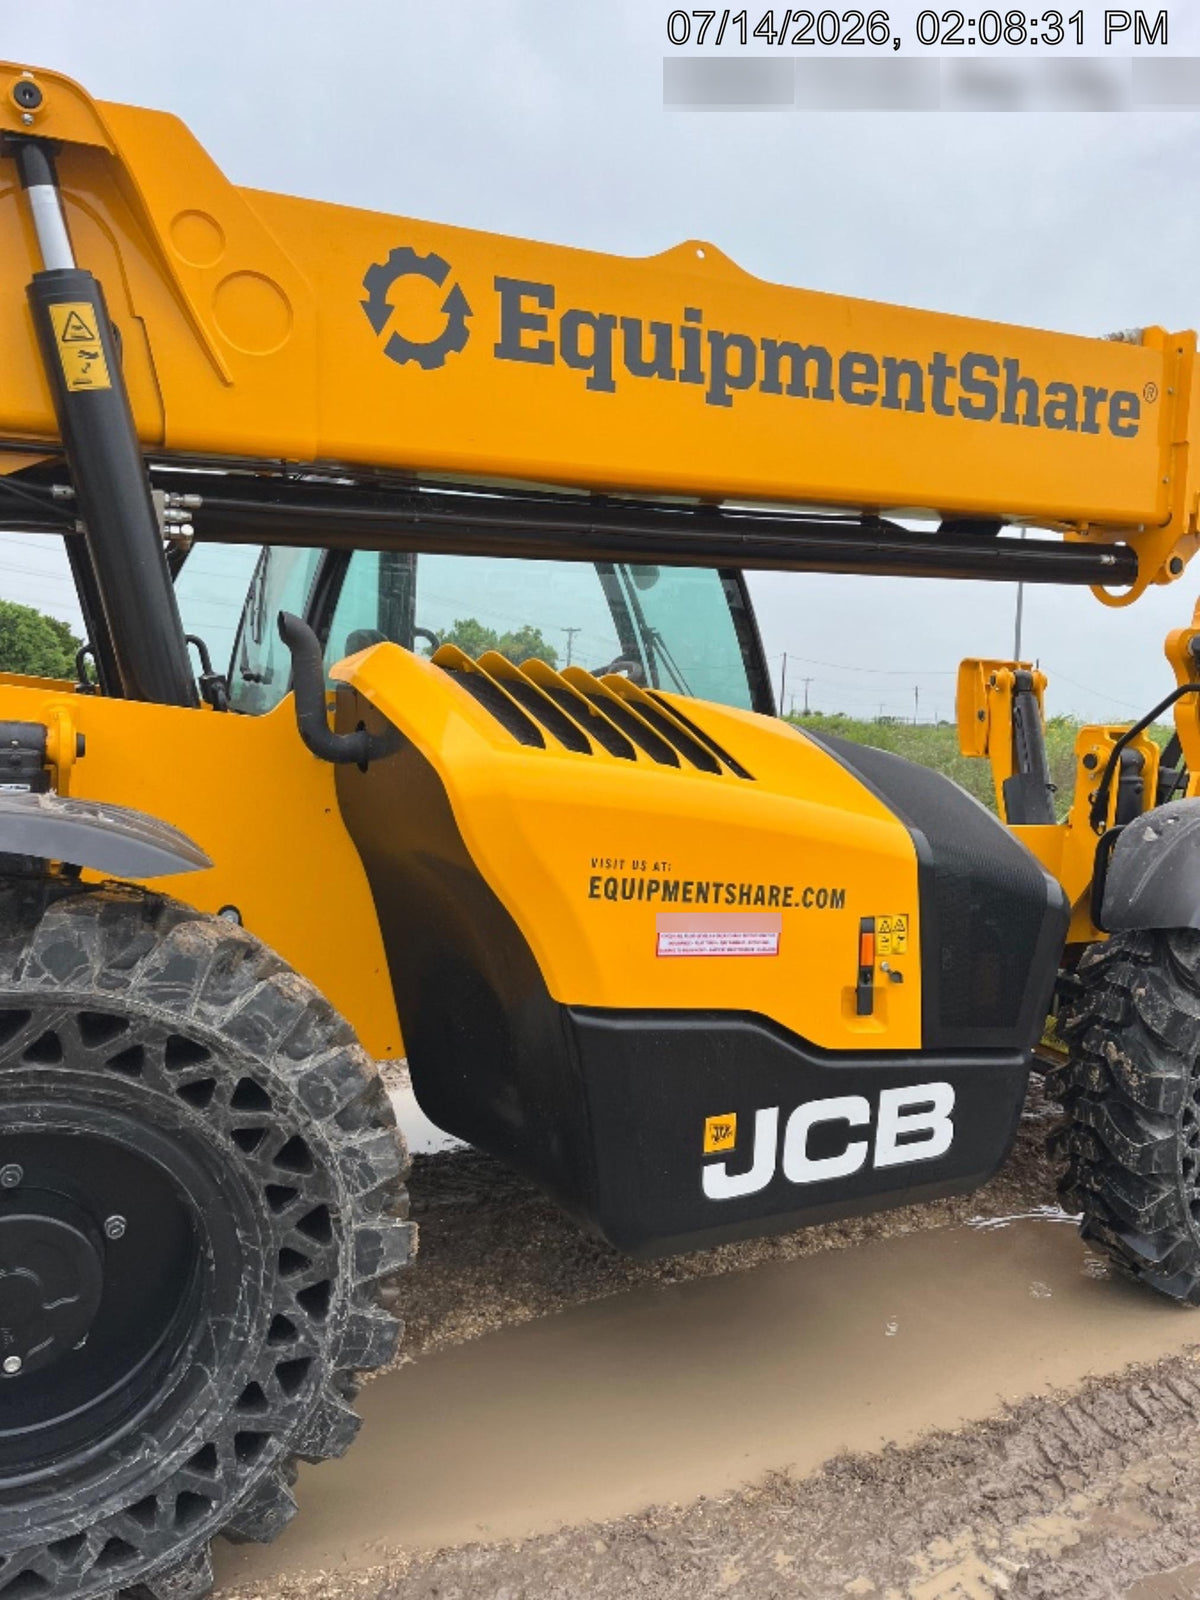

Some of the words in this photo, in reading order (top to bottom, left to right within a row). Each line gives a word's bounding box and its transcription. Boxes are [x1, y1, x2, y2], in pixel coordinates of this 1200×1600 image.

[591, 857, 625, 870] VISIT
[632, 859, 647, 872] US
[652, 861, 671, 872] AT:
[587, 875, 847, 910] EQUIPMENTSHARE.COM
[702, 1081, 956, 1200] JCB
